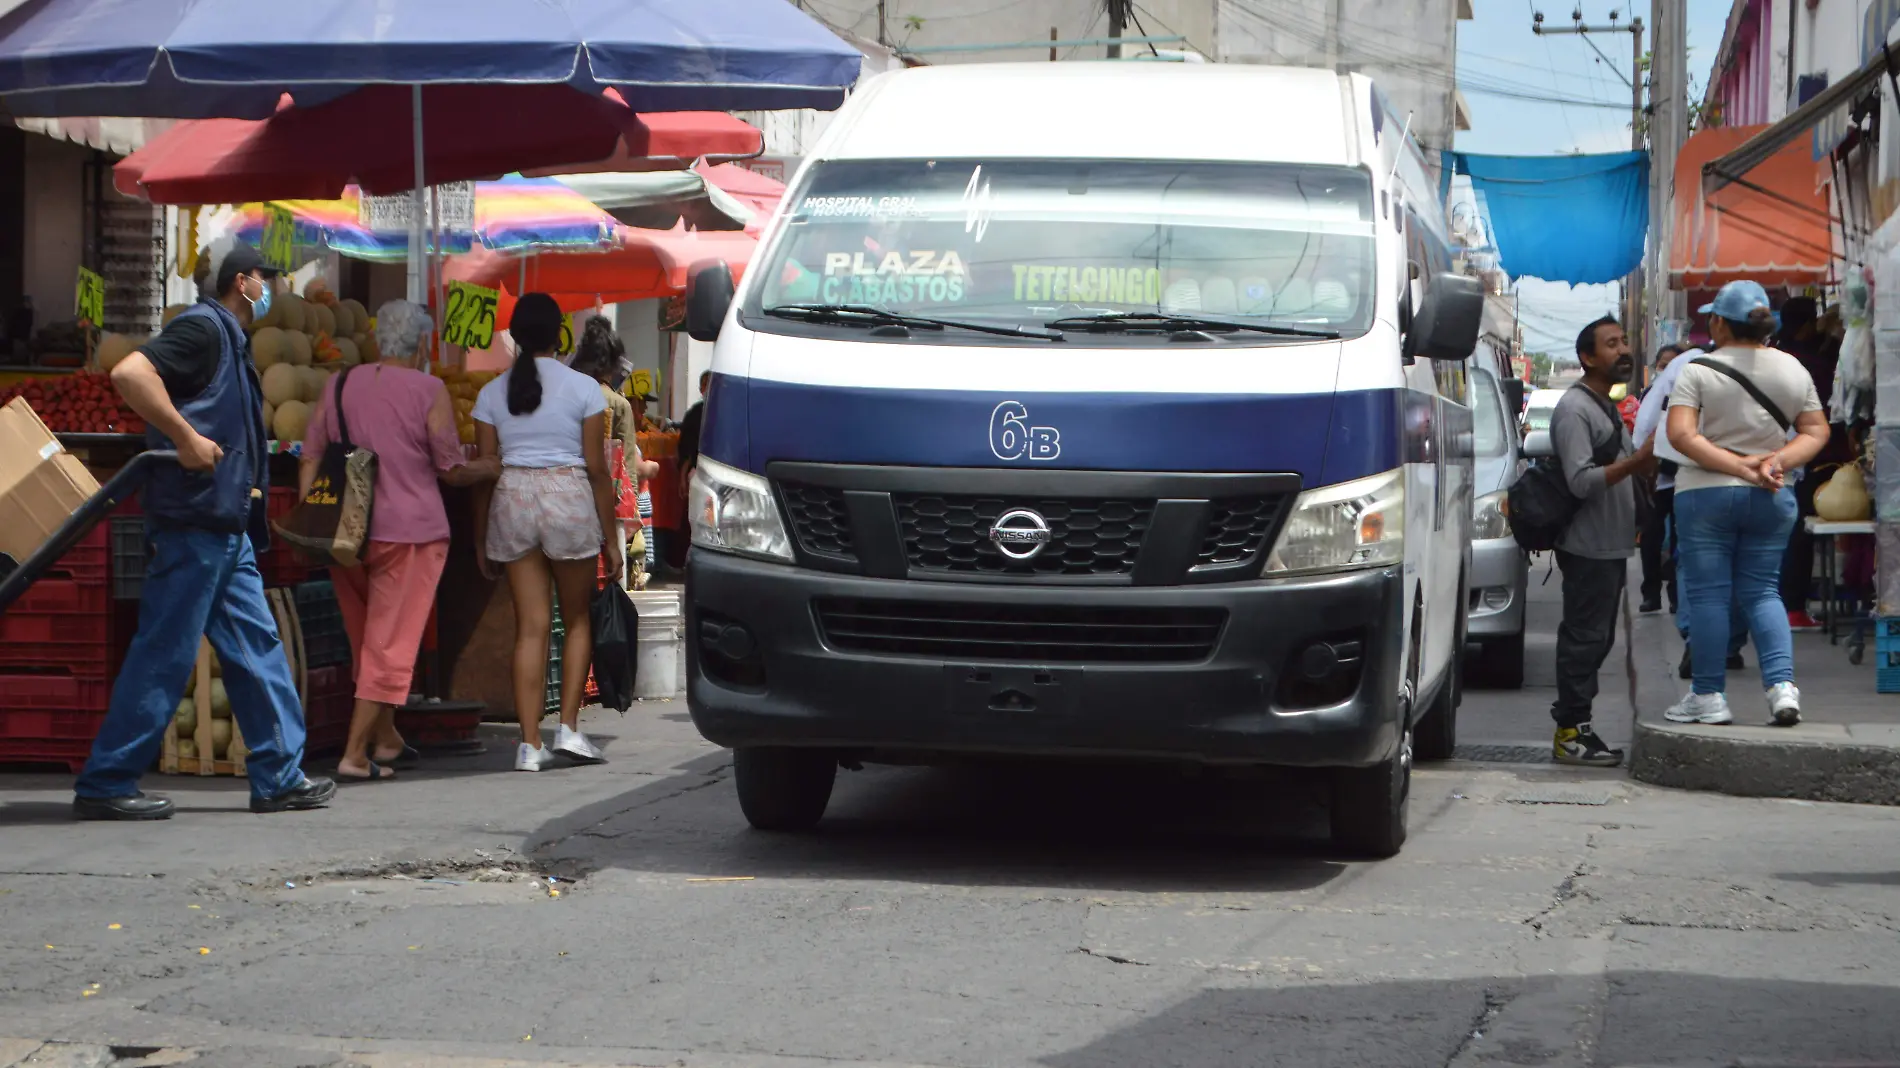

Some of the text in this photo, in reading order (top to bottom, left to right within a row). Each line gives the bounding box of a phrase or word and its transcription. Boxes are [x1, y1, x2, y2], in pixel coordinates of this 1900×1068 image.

[804, 197, 873, 209] HOSPITAL
[824, 251, 964, 276] PLAZA
[1012, 265, 1161, 304] TETELCINGO
[996, 531, 1043, 540] NISSAN
